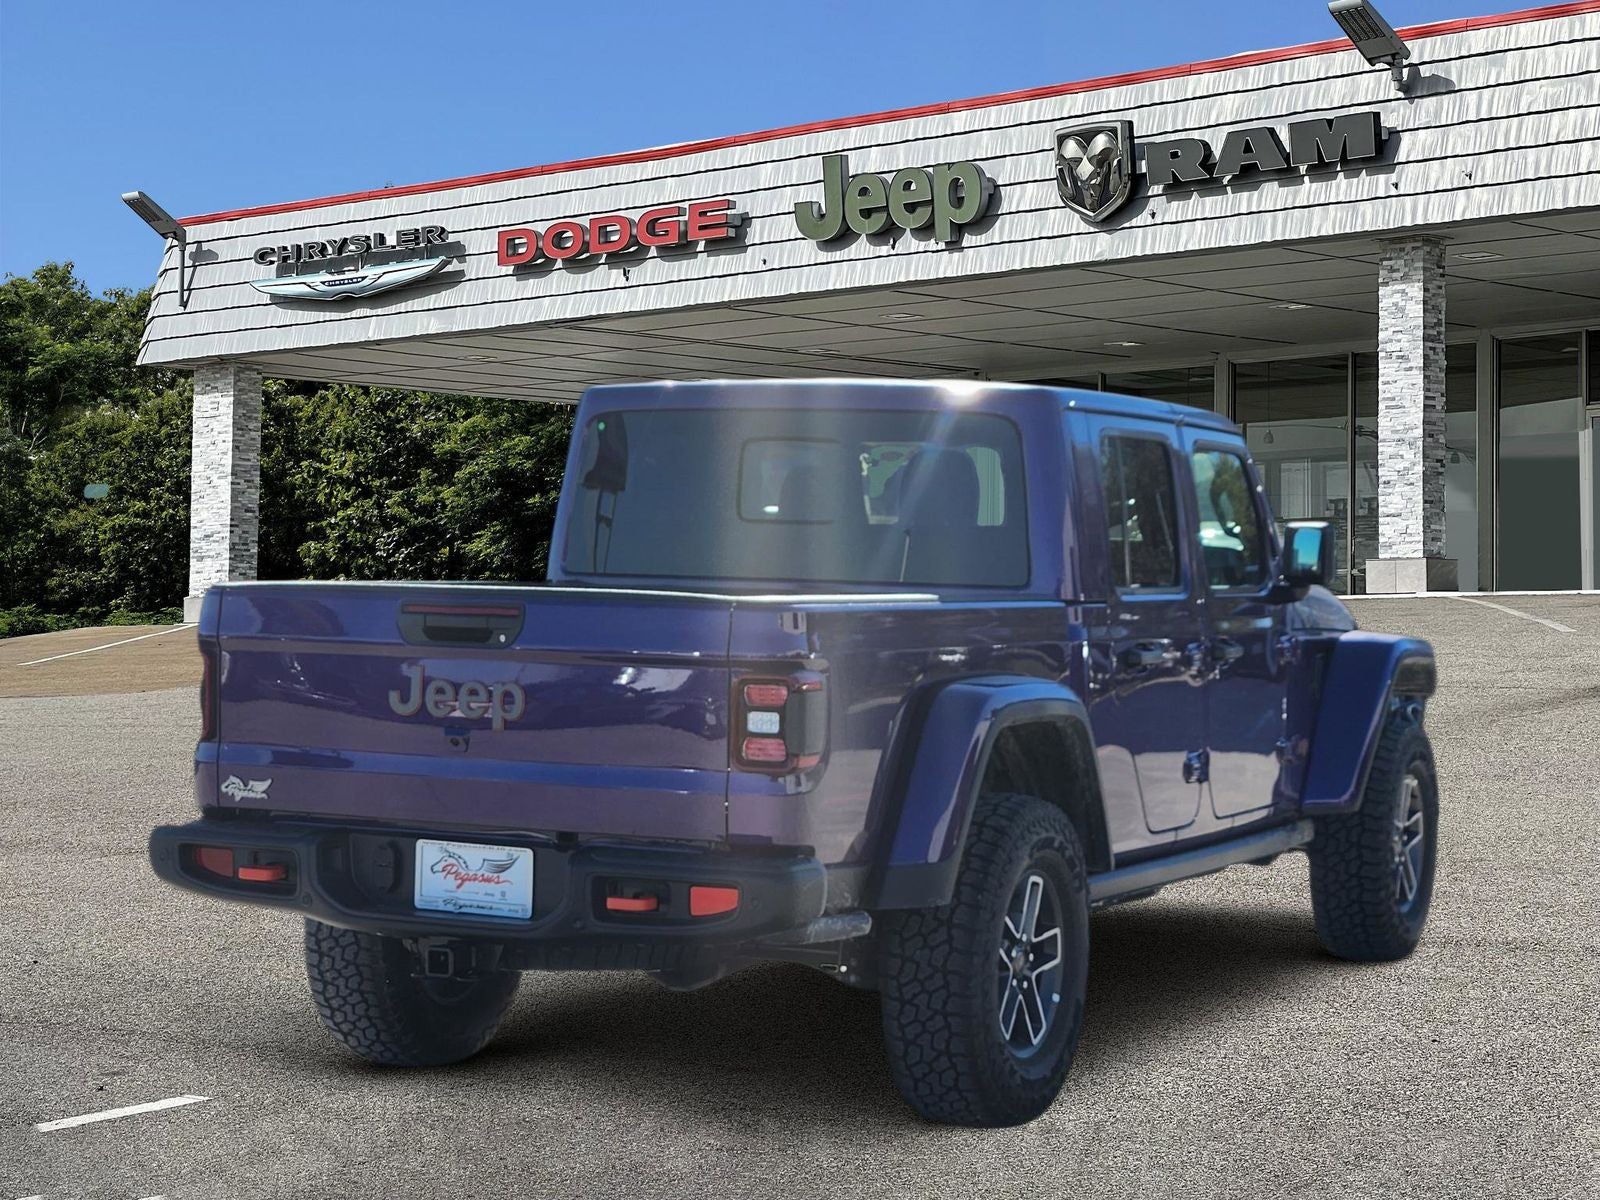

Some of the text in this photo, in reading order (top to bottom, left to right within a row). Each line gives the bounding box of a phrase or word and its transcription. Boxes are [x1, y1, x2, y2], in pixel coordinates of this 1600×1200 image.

[1147, 111, 1381, 185] RAM
[794, 154, 990, 243] Jeep
[253, 225, 448, 267] CHRYSLER
[497, 198, 734, 267] DODGE
[388, 664, 525, 729] Jeep
[441, 862, 513, 890] Pegasus
